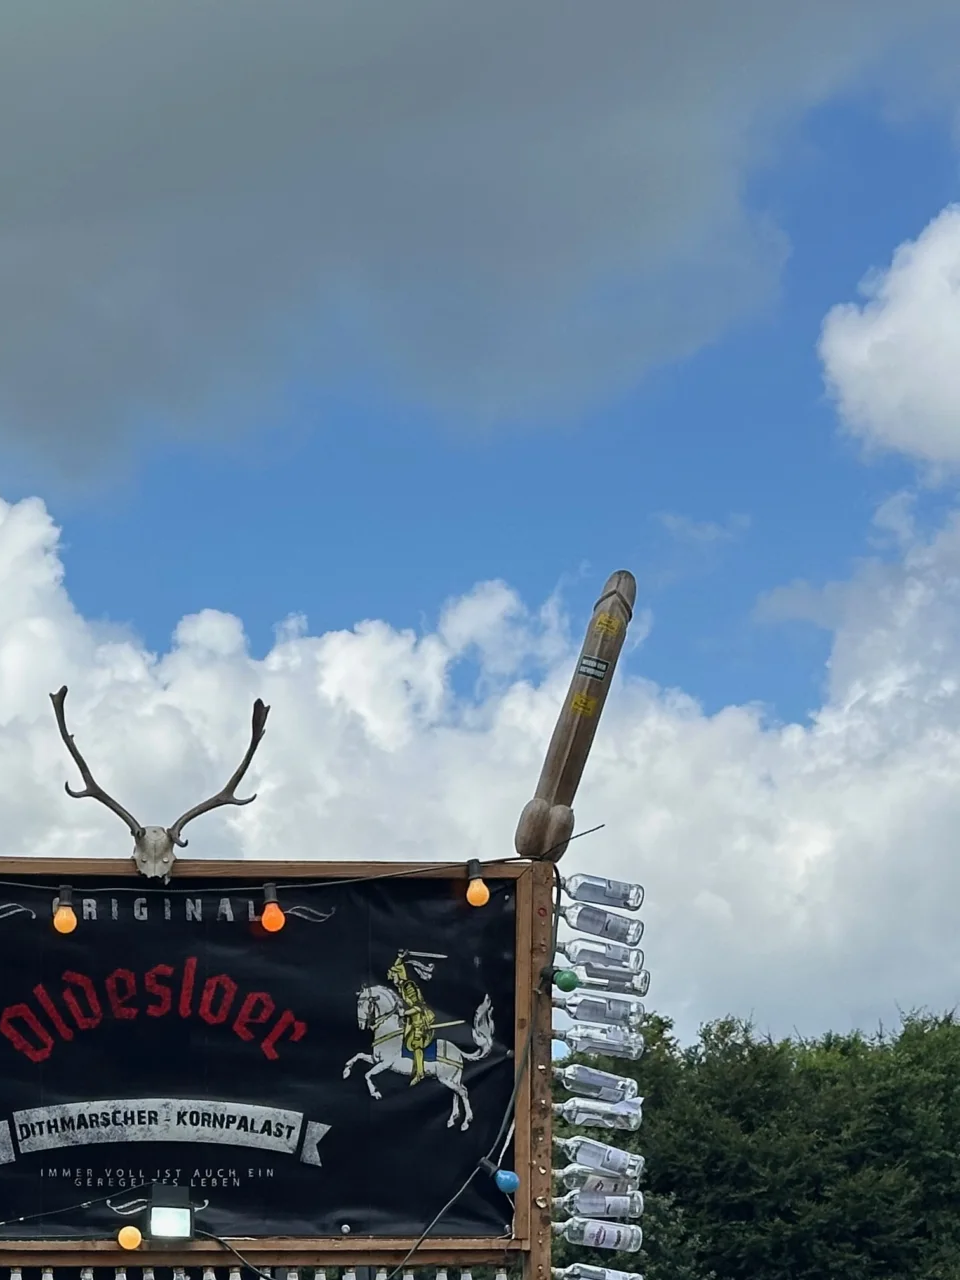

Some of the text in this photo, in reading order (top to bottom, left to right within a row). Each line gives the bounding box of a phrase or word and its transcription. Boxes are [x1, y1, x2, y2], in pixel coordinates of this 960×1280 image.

[18, 1110, 159, 1142] DITHMARSCHER
[176, 1111, 296, 1141] KORNPALAST
[40, 1168, 275, 1178] IMMER VOLL IST AUCH EIN
[190, 1177, 241, 1187] LEBEN
